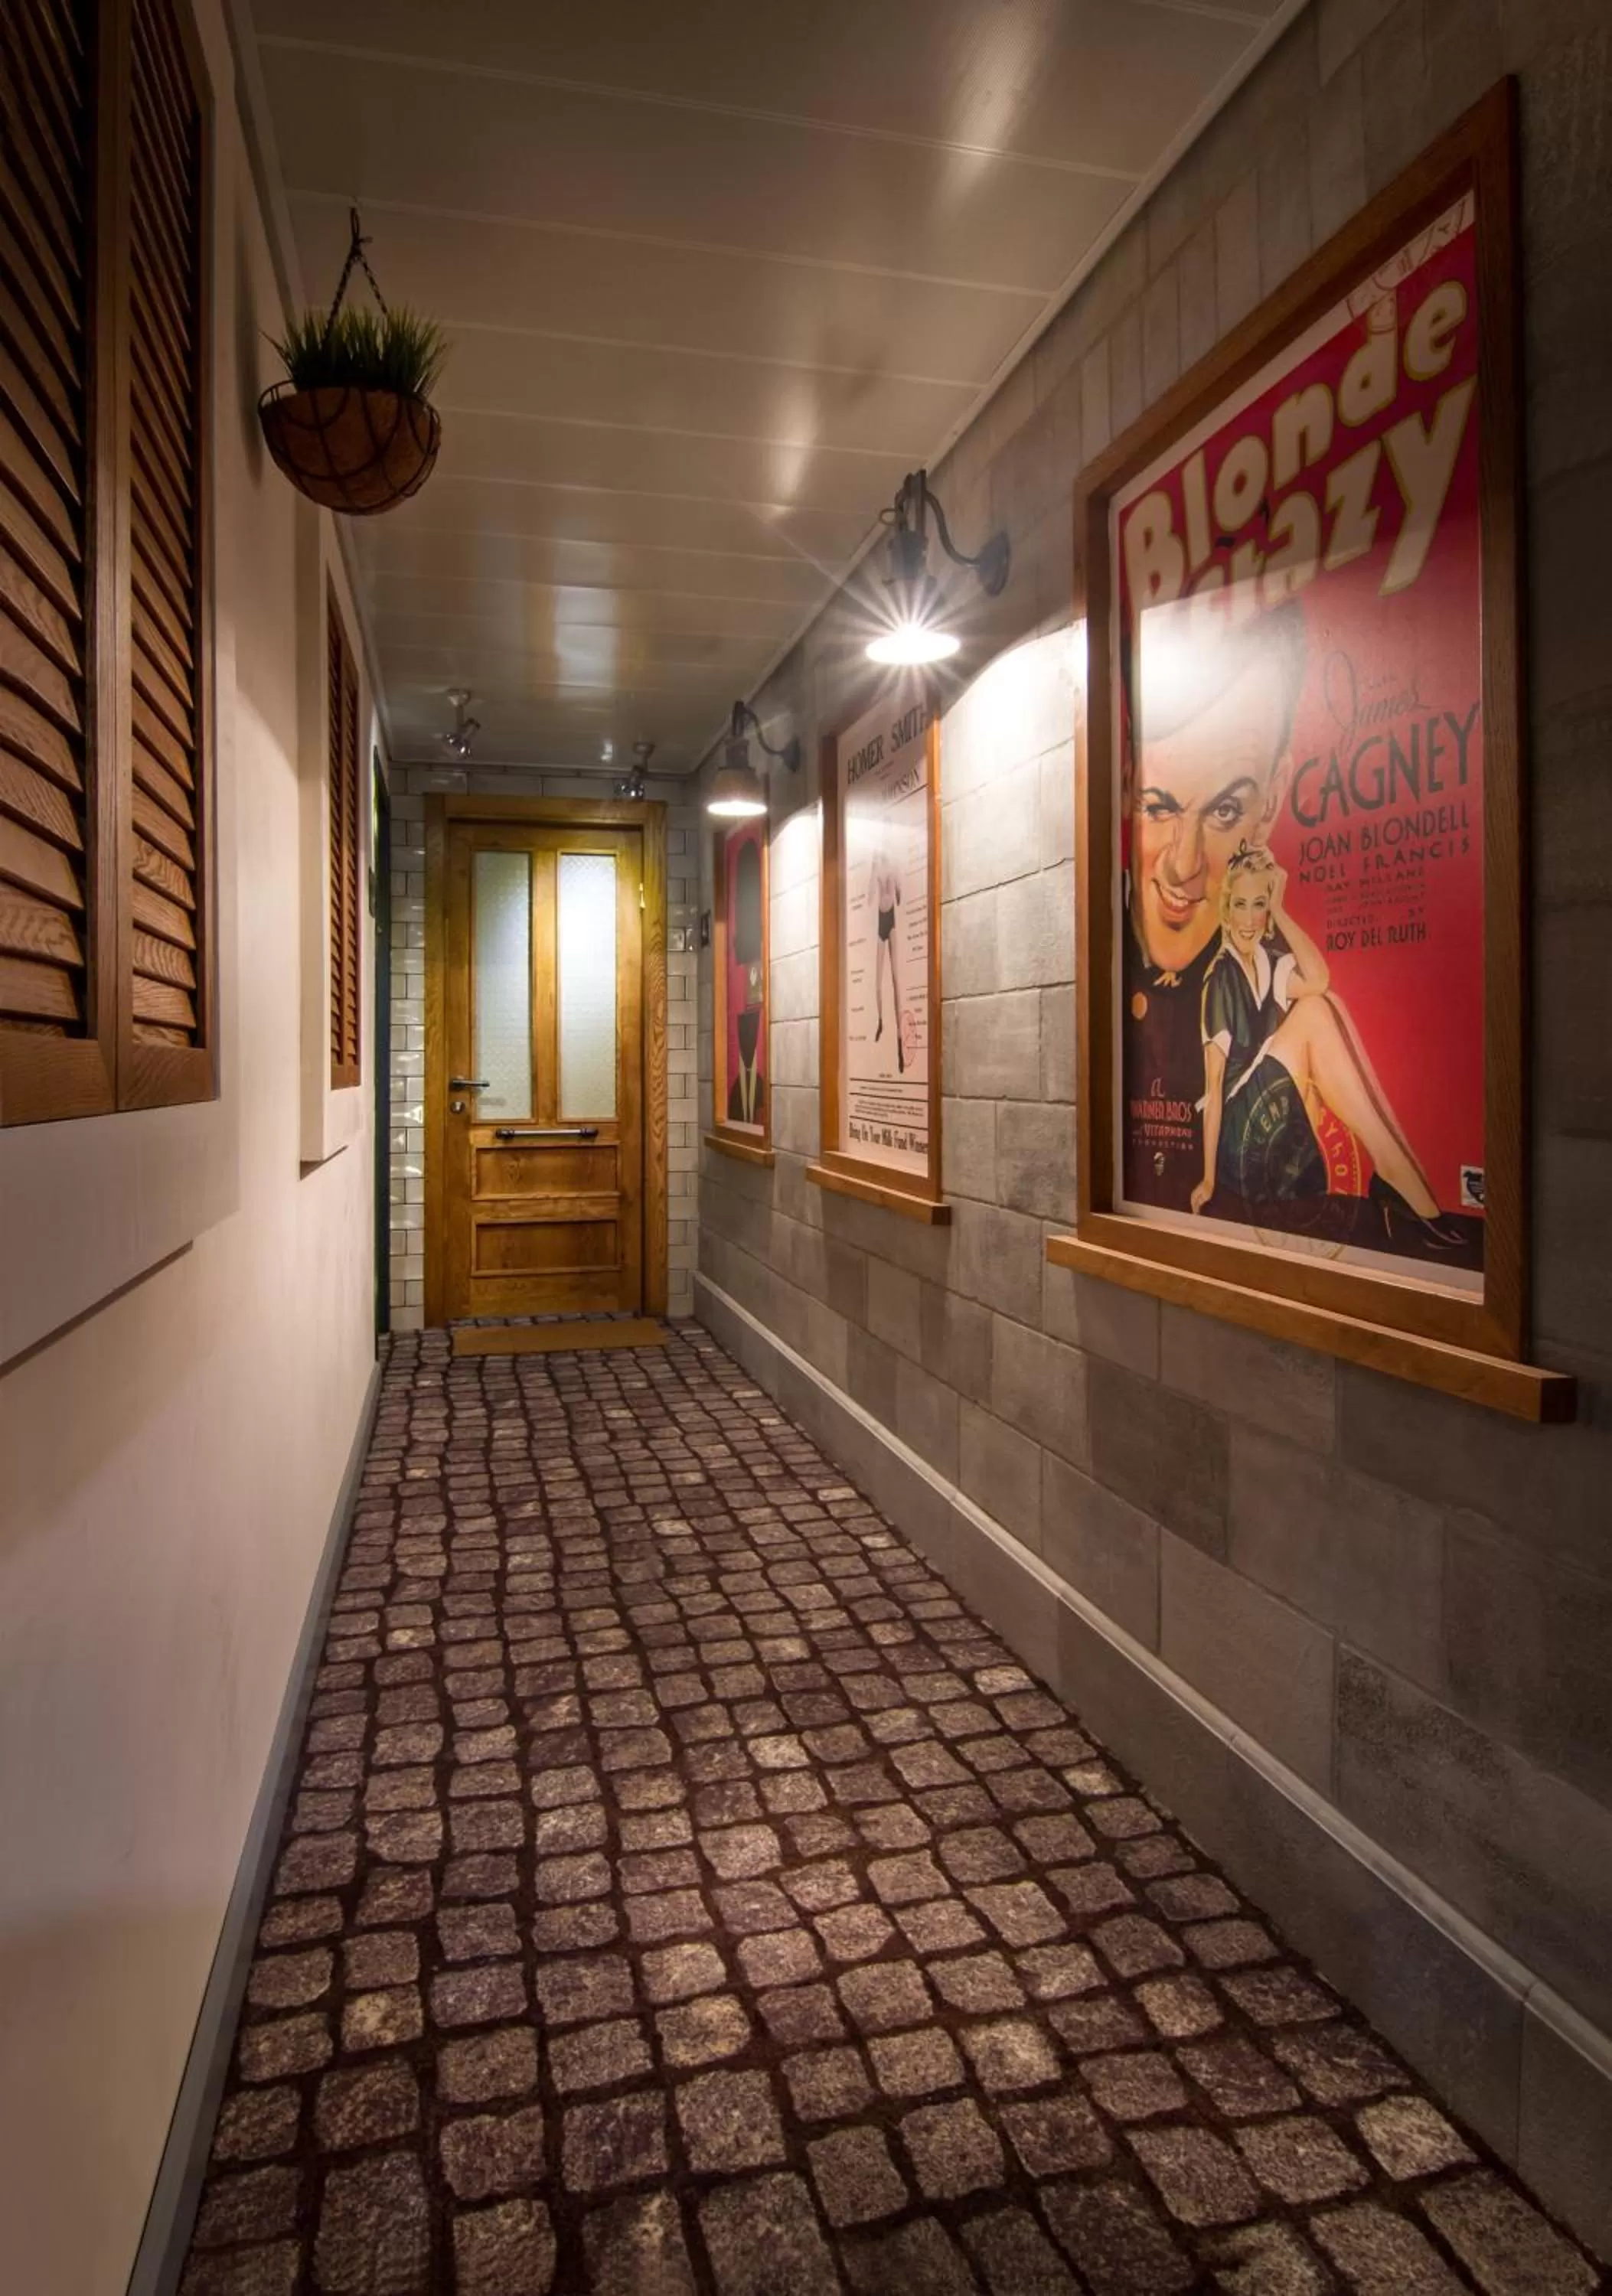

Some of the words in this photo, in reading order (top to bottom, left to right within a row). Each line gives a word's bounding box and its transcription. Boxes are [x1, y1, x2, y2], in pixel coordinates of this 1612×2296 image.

[1123, 279, 1468, 621] Blonde
[847, 735, 883, 784] HOMER
[1291, 700, 1480, 827] CAGNEY
[1299, 830, 1352, 866] JOAN
[1359, 801, 1470, 851] BLONDELL
[1362, 837, 1470, 872] FRANCIS
[1326, 931, 1356, 951] ROY
[1361, 927, 1382, 947] DEL
[1388, 921, 1426, 944] RUTH
